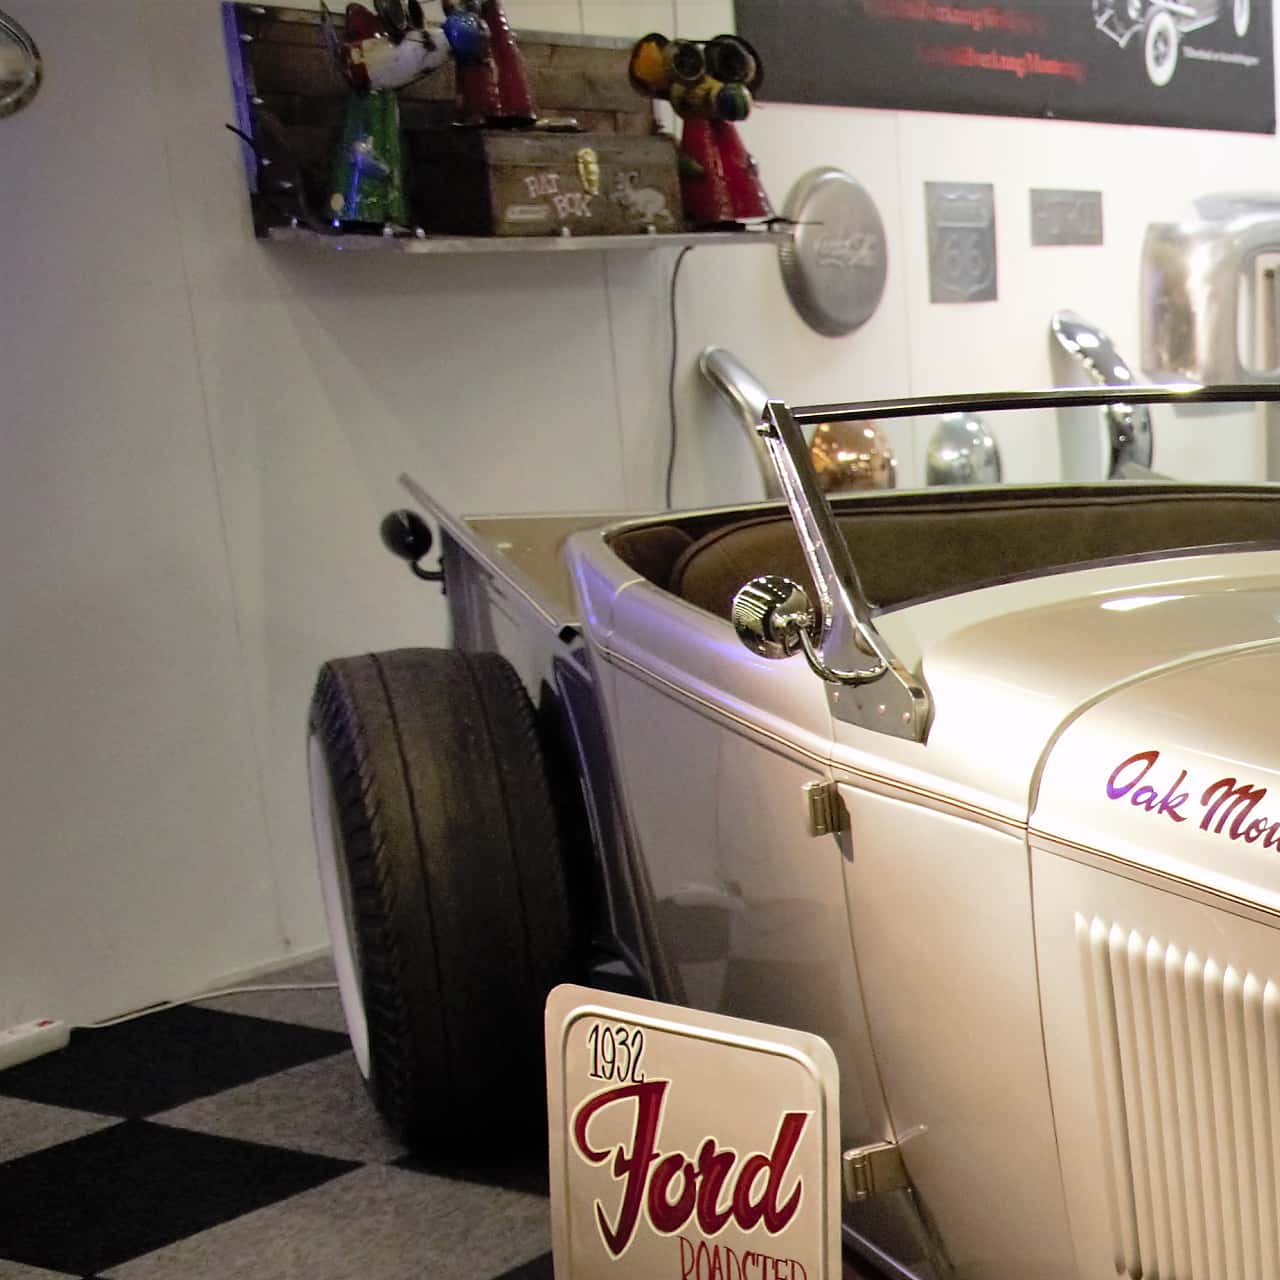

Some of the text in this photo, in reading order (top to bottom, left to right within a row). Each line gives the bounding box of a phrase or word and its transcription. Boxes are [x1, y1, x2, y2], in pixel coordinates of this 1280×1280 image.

[1106, 750, 1188, 823] Oak
[587, 1022, 646, 1084] 1932
[571, 1079, 815, 1261] Ford
